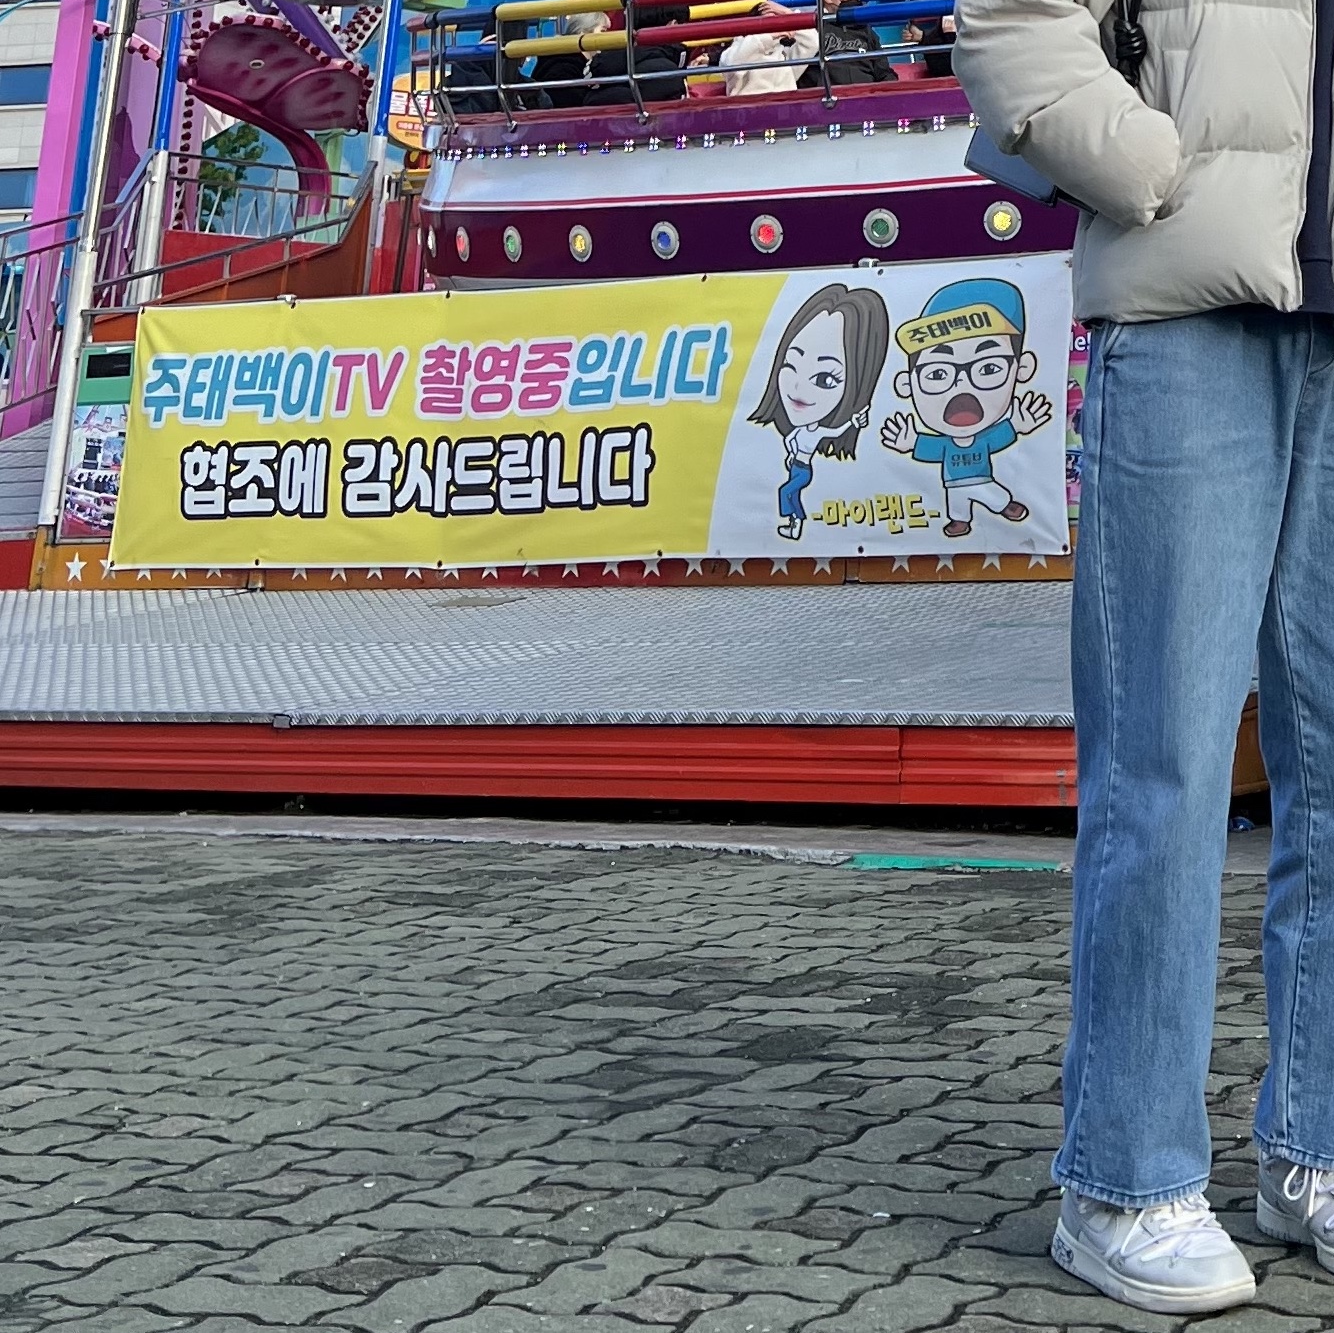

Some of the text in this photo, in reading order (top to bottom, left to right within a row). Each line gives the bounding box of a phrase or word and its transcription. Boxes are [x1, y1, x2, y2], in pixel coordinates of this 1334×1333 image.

[143, 326, 728, 423] 주태백이TV 촬영중입니다
[906, 310, 993, 344] 주태백이
[181, 423, 655, 519] 협조에 감사드립니다
